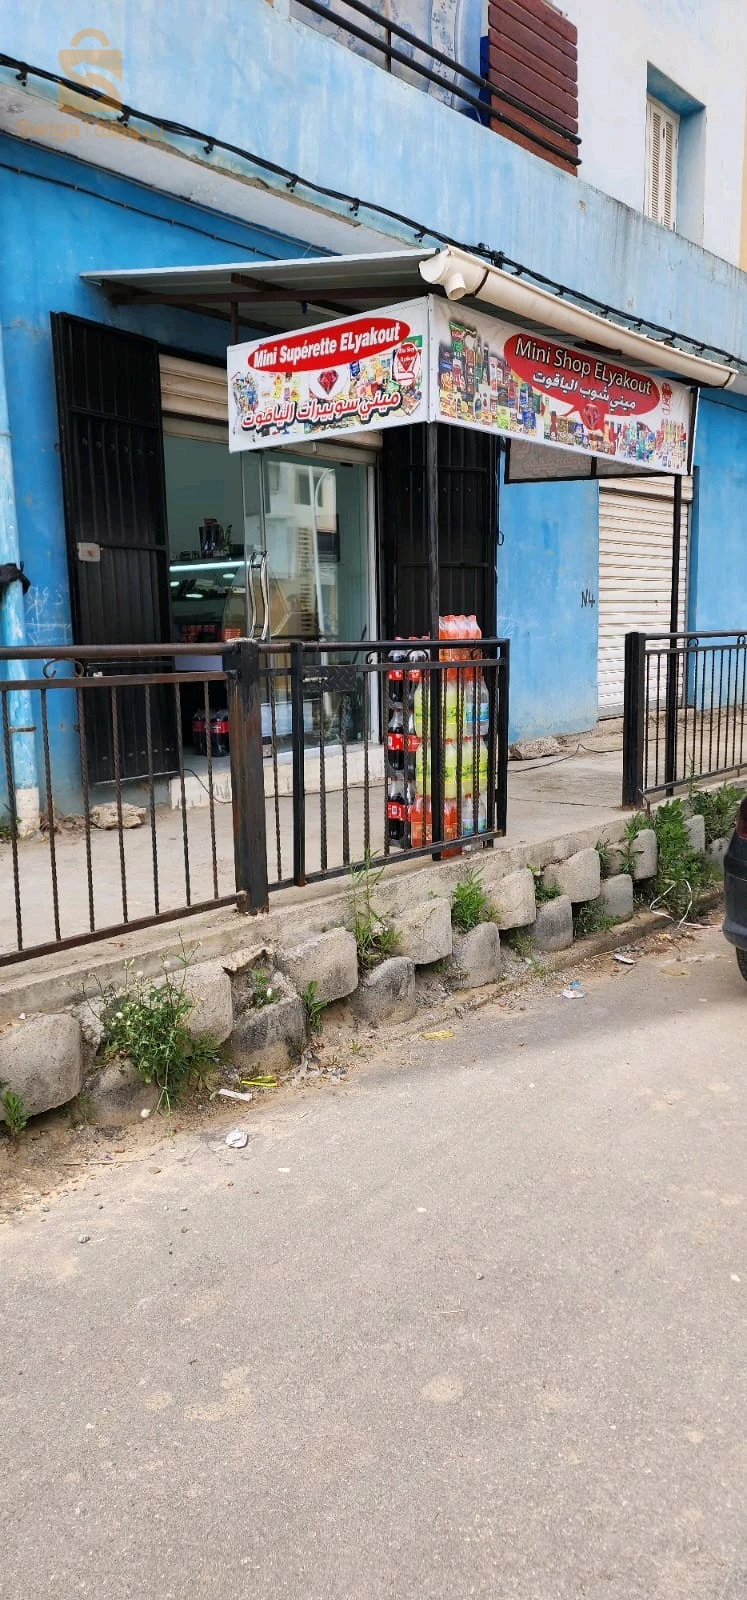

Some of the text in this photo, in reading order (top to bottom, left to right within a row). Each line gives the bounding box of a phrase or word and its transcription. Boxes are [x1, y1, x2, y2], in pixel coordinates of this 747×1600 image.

[254, 322, 401, 368] Mini Supérette ELyakout
[514, 337, 653, 395] Mini Shop ELyakout
[358, 391, 402, 420] ميني
[531, 371, 637, 413] ميني شوب الياقوت
[241, 401, 295, 429] الياقوت
